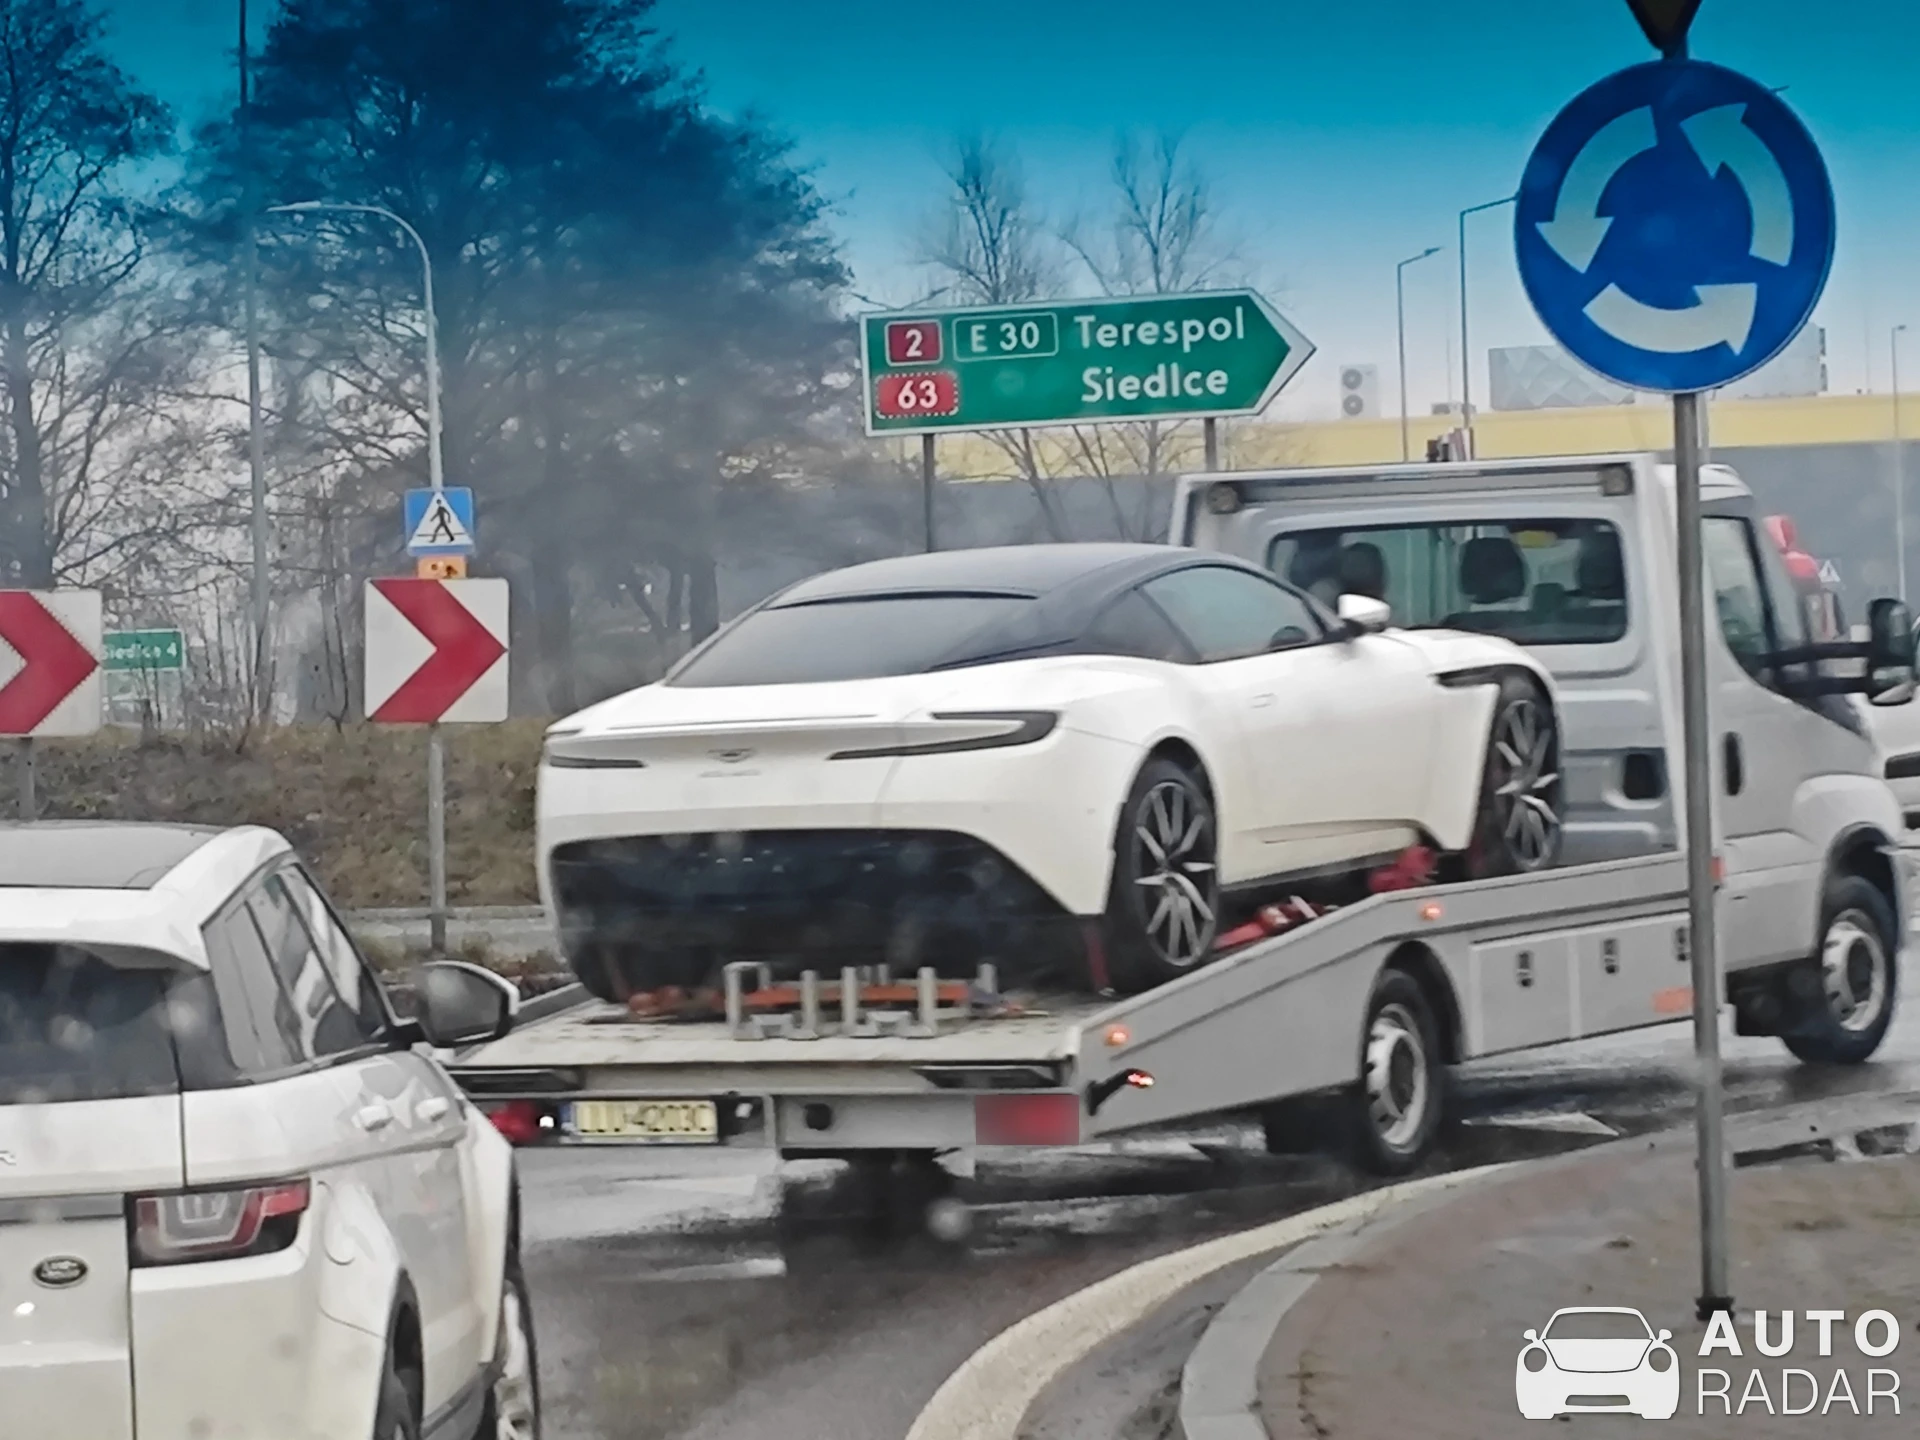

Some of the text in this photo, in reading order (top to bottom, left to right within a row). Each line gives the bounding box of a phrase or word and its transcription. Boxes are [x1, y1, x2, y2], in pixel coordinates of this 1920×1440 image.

[904, 328, 924, 358] 2
[969, 320, 1041, 353] E 30
[1073, 305, 1245, 354] Terespol
[897, 378, 939, 410] 63
[1080, 363, 1230, 403] Siedlce
